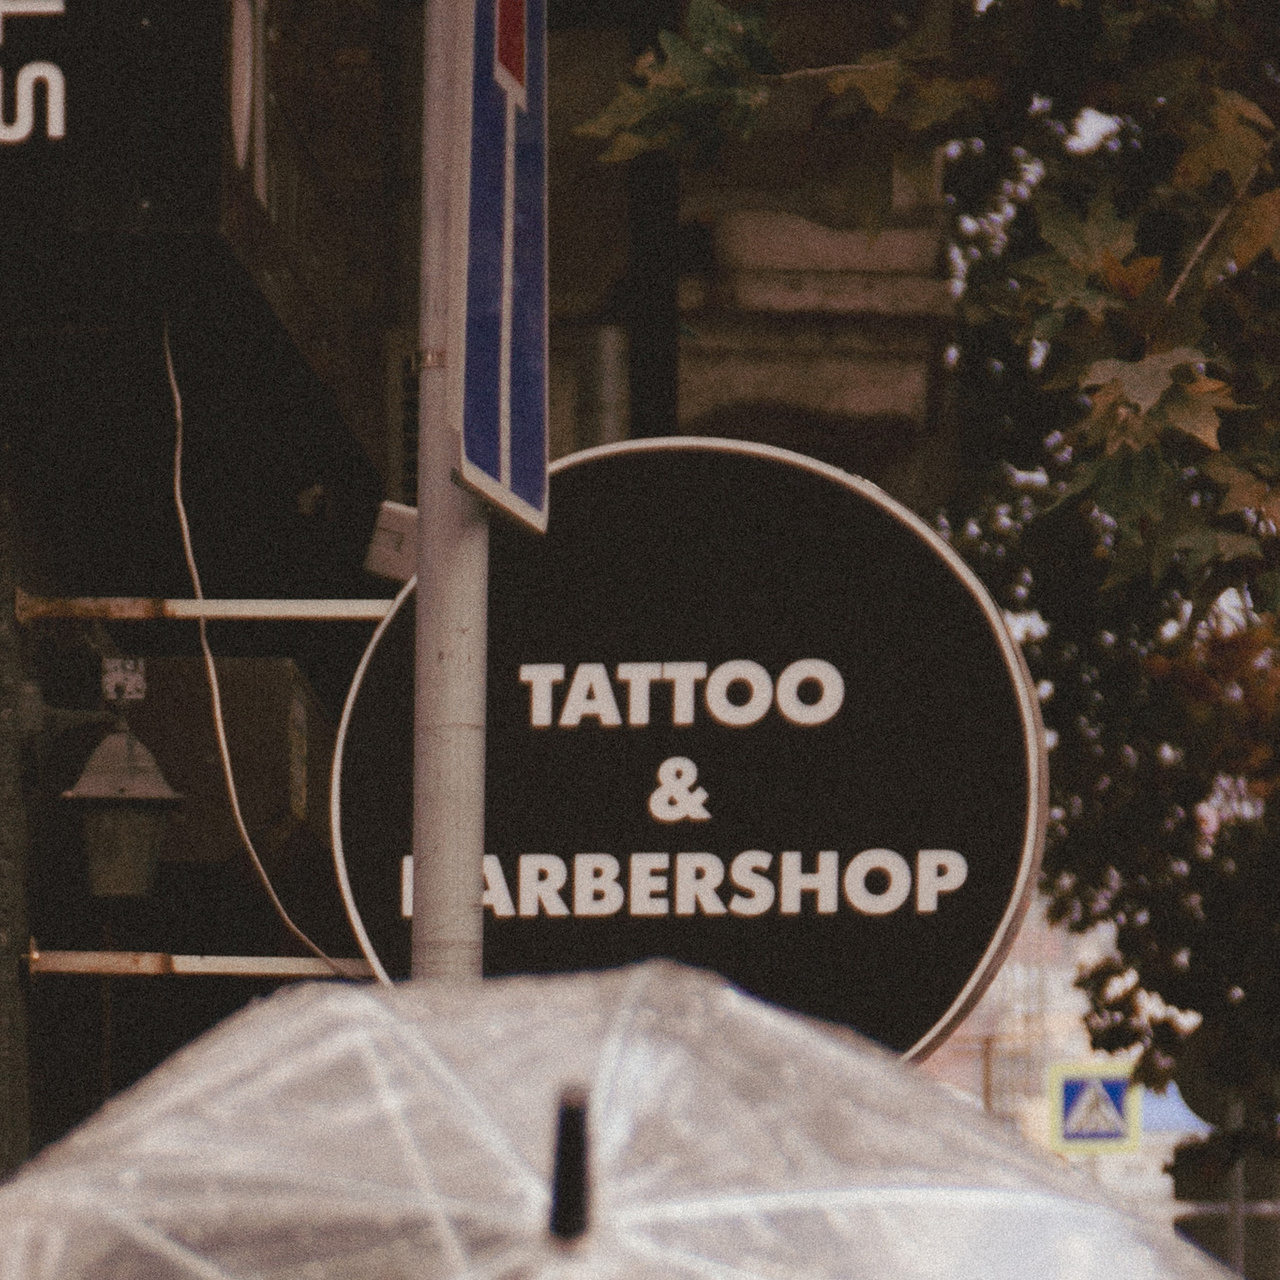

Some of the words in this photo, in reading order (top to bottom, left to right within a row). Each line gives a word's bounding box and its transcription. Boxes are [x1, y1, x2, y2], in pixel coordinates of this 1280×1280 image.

[518, 658, 845, 728] TATTOO
[648, 756, 712, 823] &
[402, 848, 969, 918] ARBERSHOP
